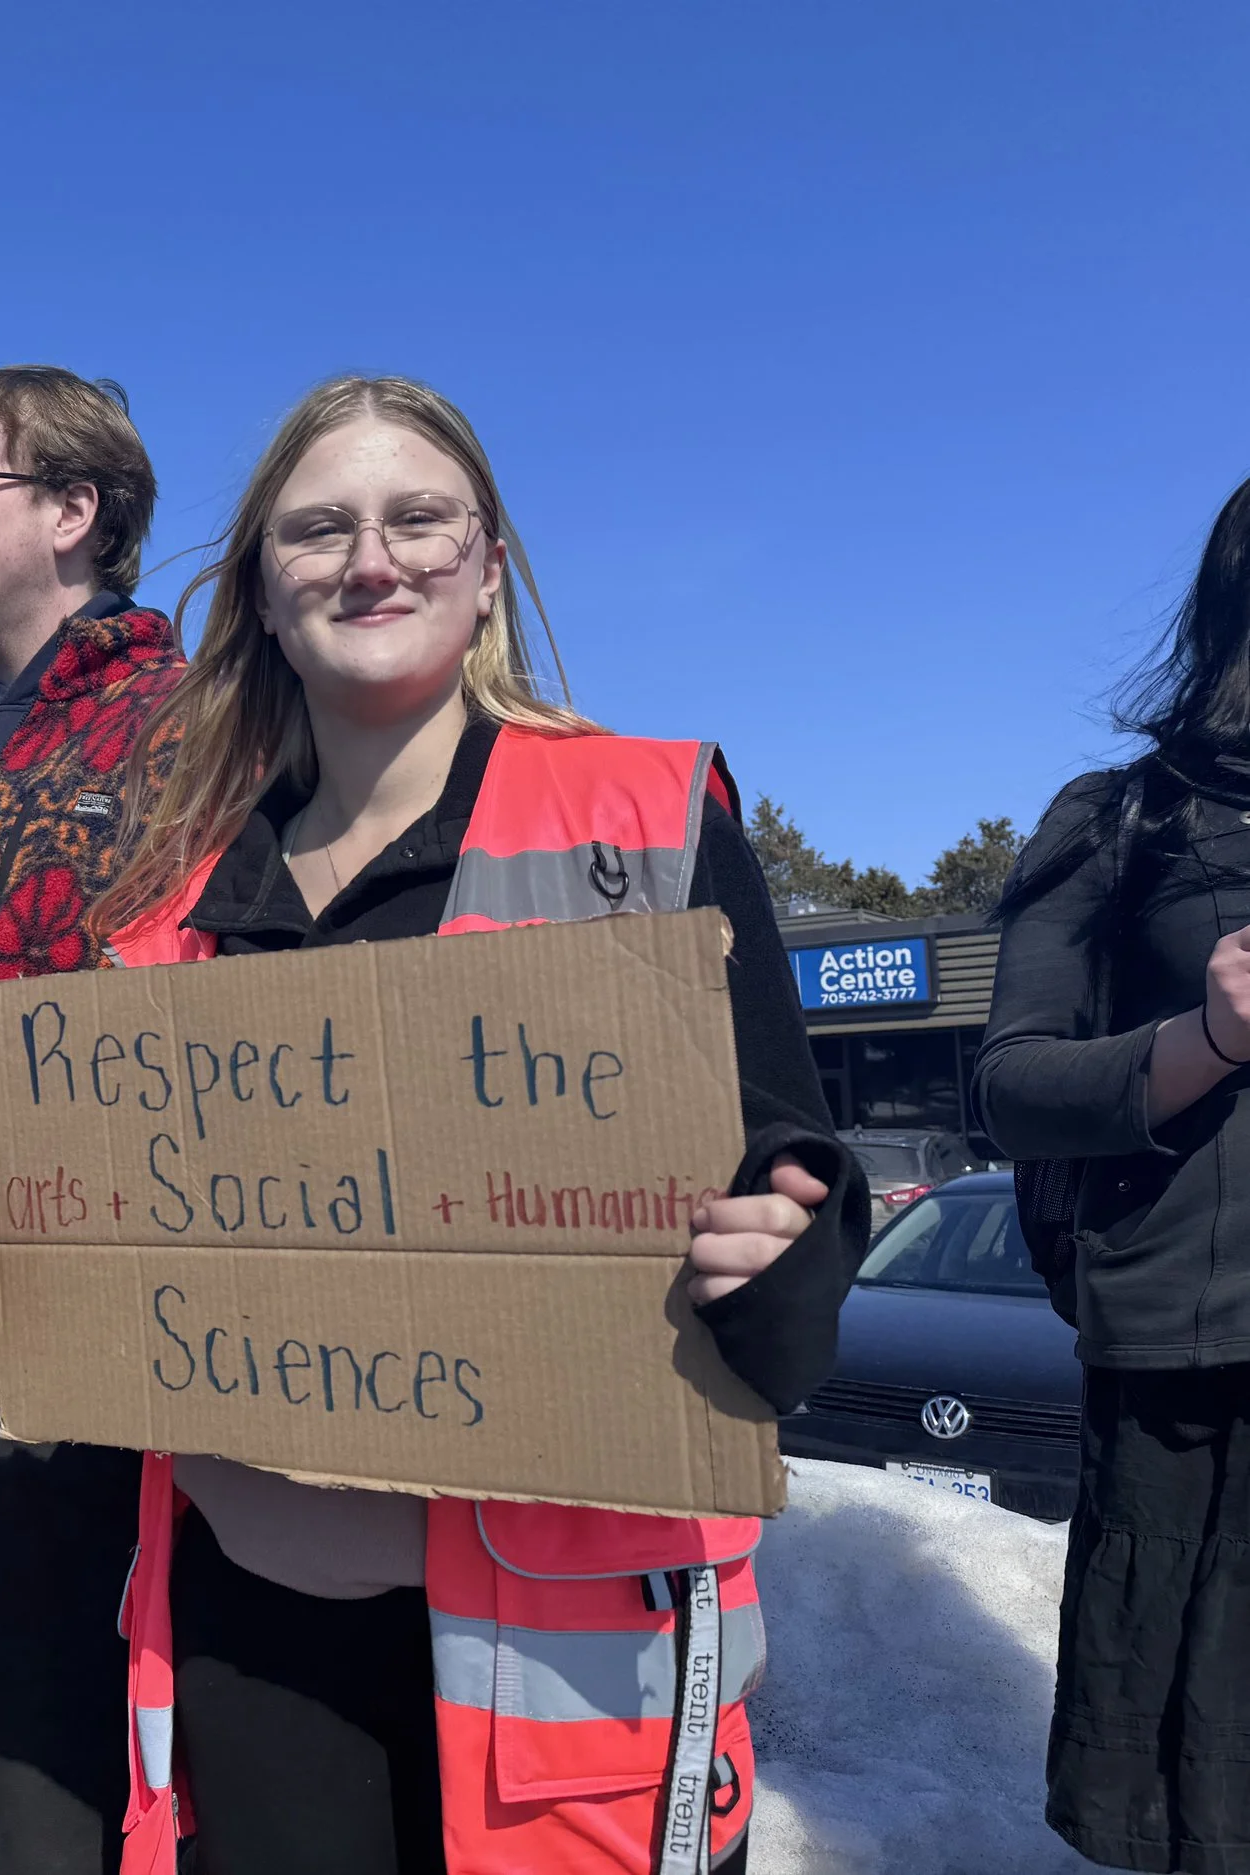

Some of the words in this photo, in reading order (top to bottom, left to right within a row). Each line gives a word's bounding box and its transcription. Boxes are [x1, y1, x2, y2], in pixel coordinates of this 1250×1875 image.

[819, 946, 913, 973] Action
[820, 967, 916, 993] Centre
[820, 987, 917, 1005] 705-742-3777
[21, 1000, 354, 1140] Respect
[460, 1015, 623, 1120] the
[6, 1166, 88, 1234] arts
[149, 1133, 395, 1234] Social
[153, 1284, 485, 1427] Sciences
[687, 1652, 714, 1734] trent
[669, 1773, 698, 1854] trent
